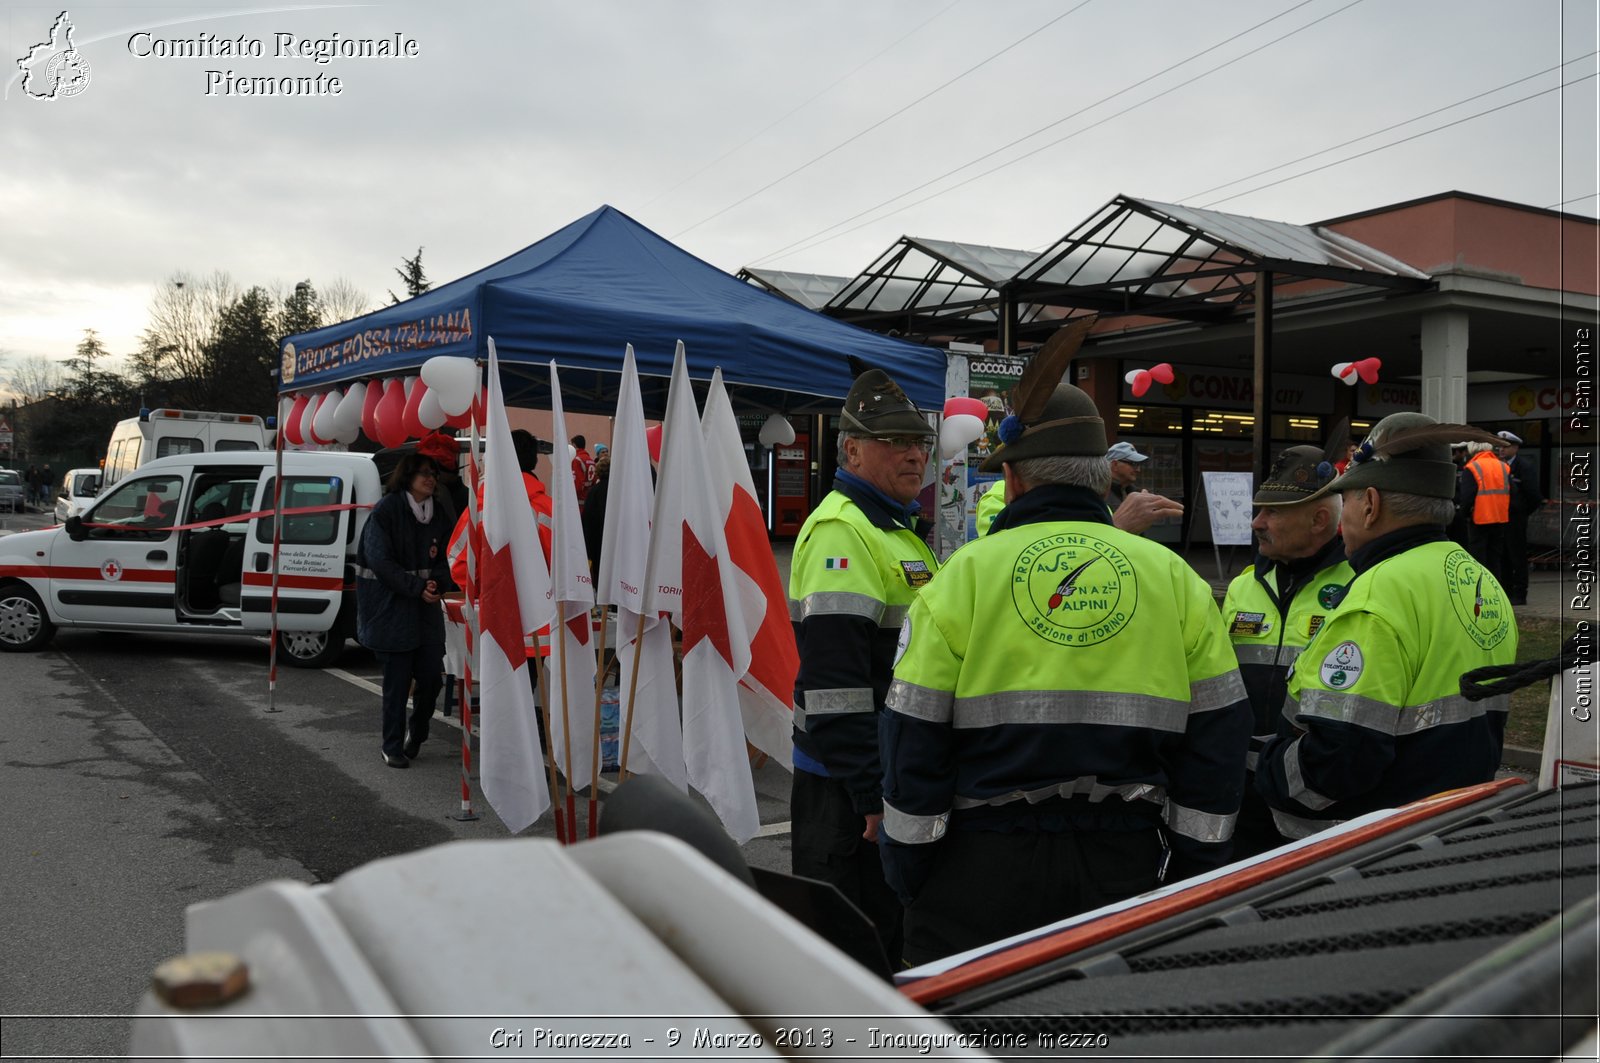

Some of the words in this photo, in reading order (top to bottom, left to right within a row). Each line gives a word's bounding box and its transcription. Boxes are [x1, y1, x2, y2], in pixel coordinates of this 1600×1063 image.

[297, 342, 340, 374] CROCE
[342, 328, 391, 365] ROSSA
[394, 308, 472, 352] ITALIANA
[970, 361, 1024, 376] CIOCCOLATO
[1189, 374, 1255, 401] CONA
[1276, 389, 1304, 405] CITY
[1381, 387, 1420, 406] CONA
[1015, 536, 1087, 583] PROTEZIONE
[1093, 541, 1131, 577] CIVILE
[620, 581, 638, 595] TORINO
[1062, 599, 1108, 611] ALPINI
[1031, 616, 1073, 642] Sezione
[1092, 612, 1125, 640] TORINO
